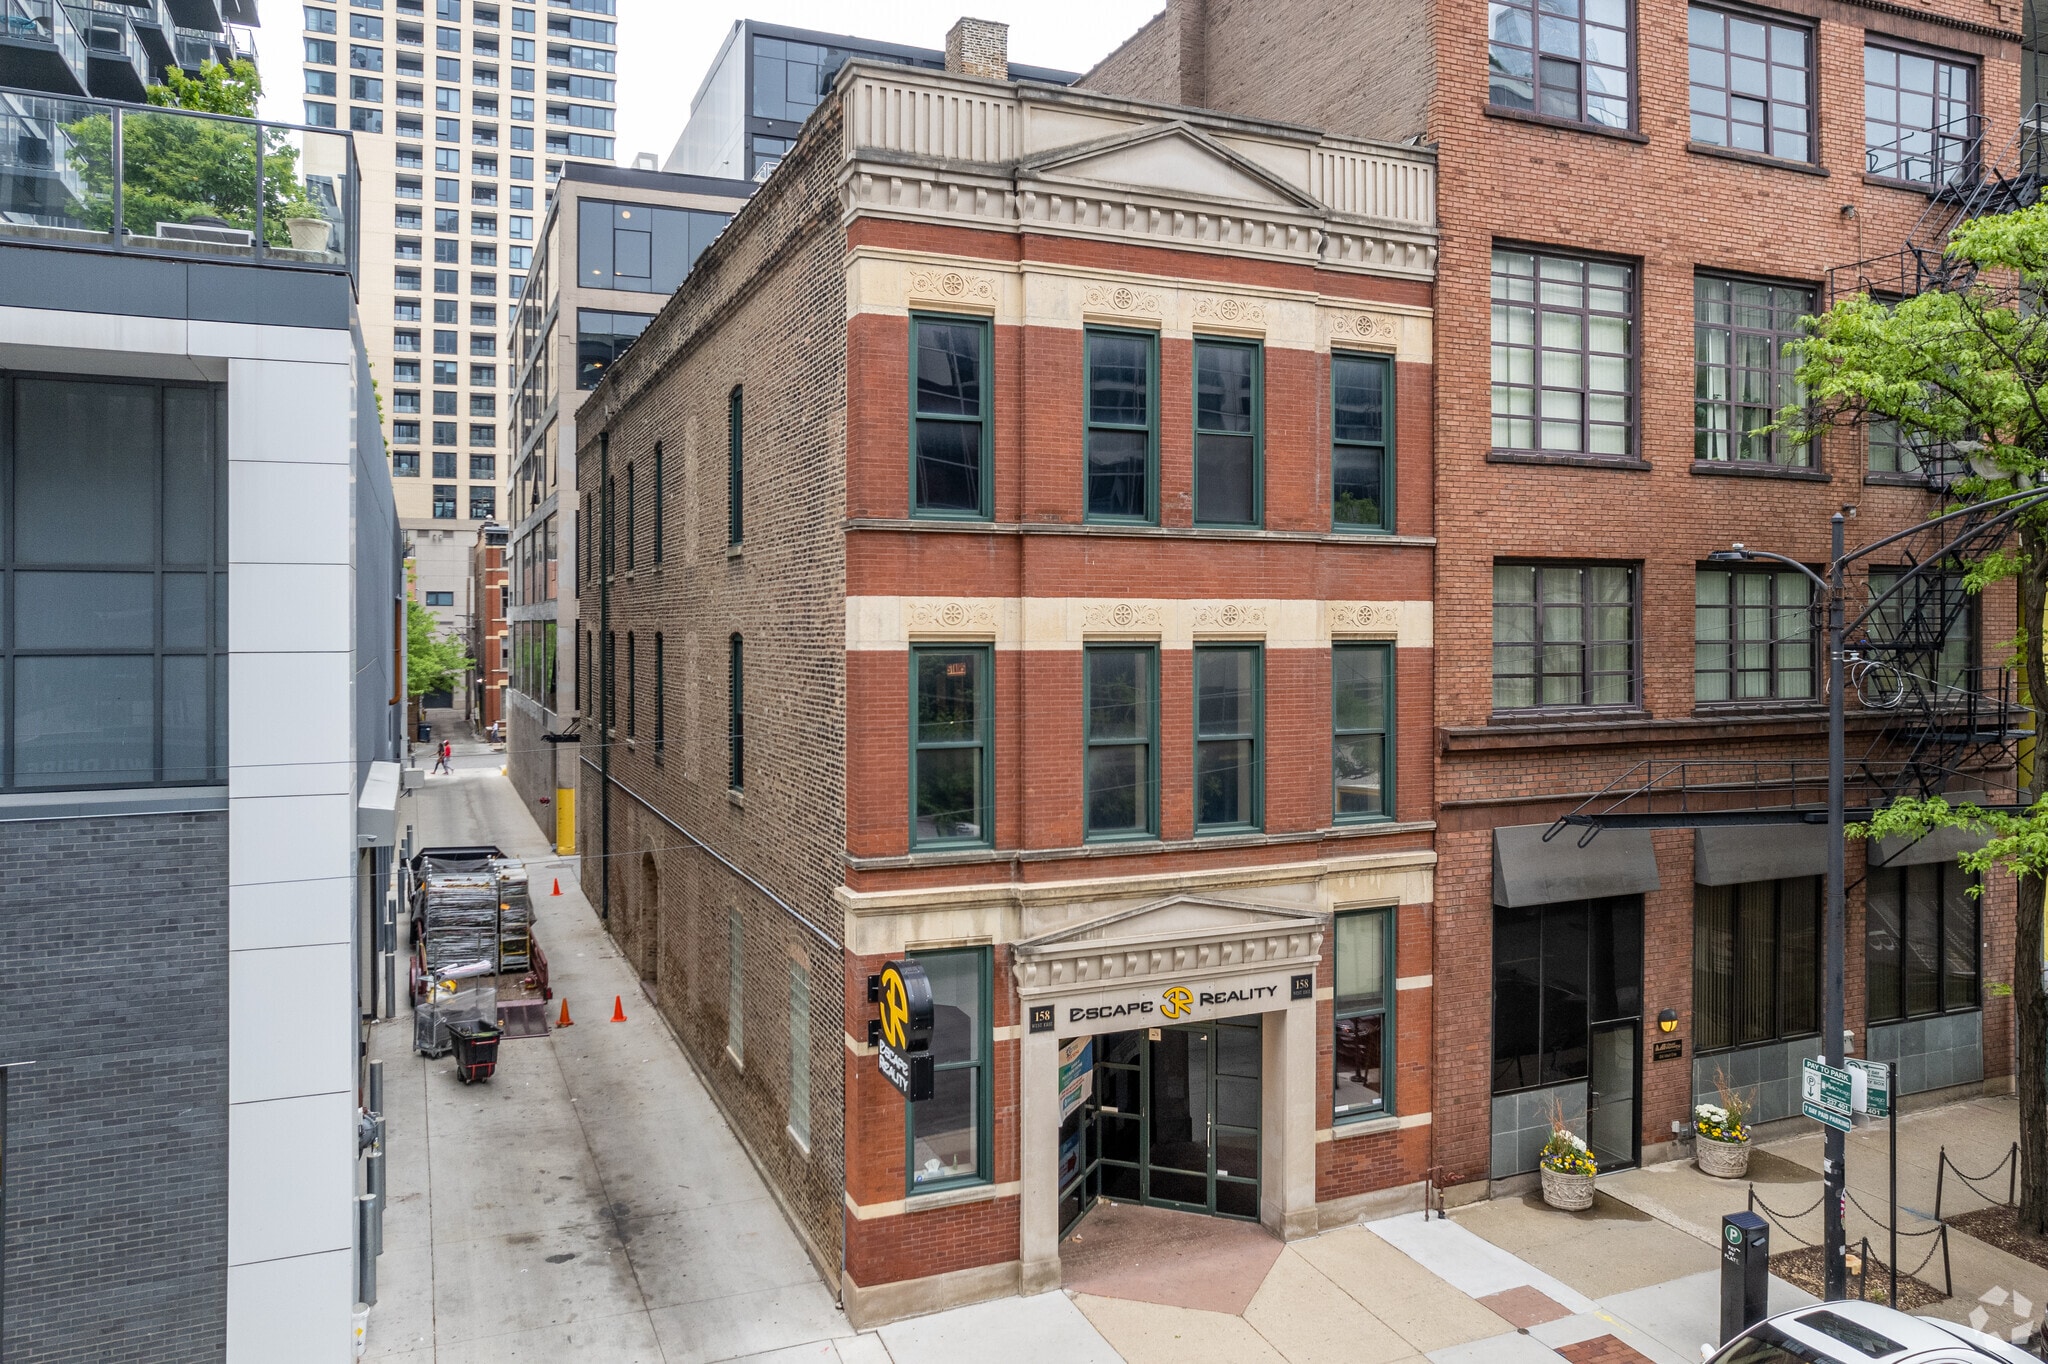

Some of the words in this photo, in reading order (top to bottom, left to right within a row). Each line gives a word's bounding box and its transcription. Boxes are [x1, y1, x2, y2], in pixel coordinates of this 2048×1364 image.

[1295, 979, 1309, 990] 158
[1069, 1001, 1154, 1022] ESCAPE
[1200, 985, 1278, 1007] REALITY
[1035, 1010, 1050, 1022] 158
[879, 1038, 909, 1077] ESCAPE
[879, 1054, 909, 1092] REALITY
[1806, 1061, 1820, 1071] PAY
[1820, 1066, 1830, 1074] TO
[1830, 1070, 1849, 1081] PARK
[1829, 1115, 1850, 1128] PARKING
[1727, 1244, 1741, 1253] PAY
